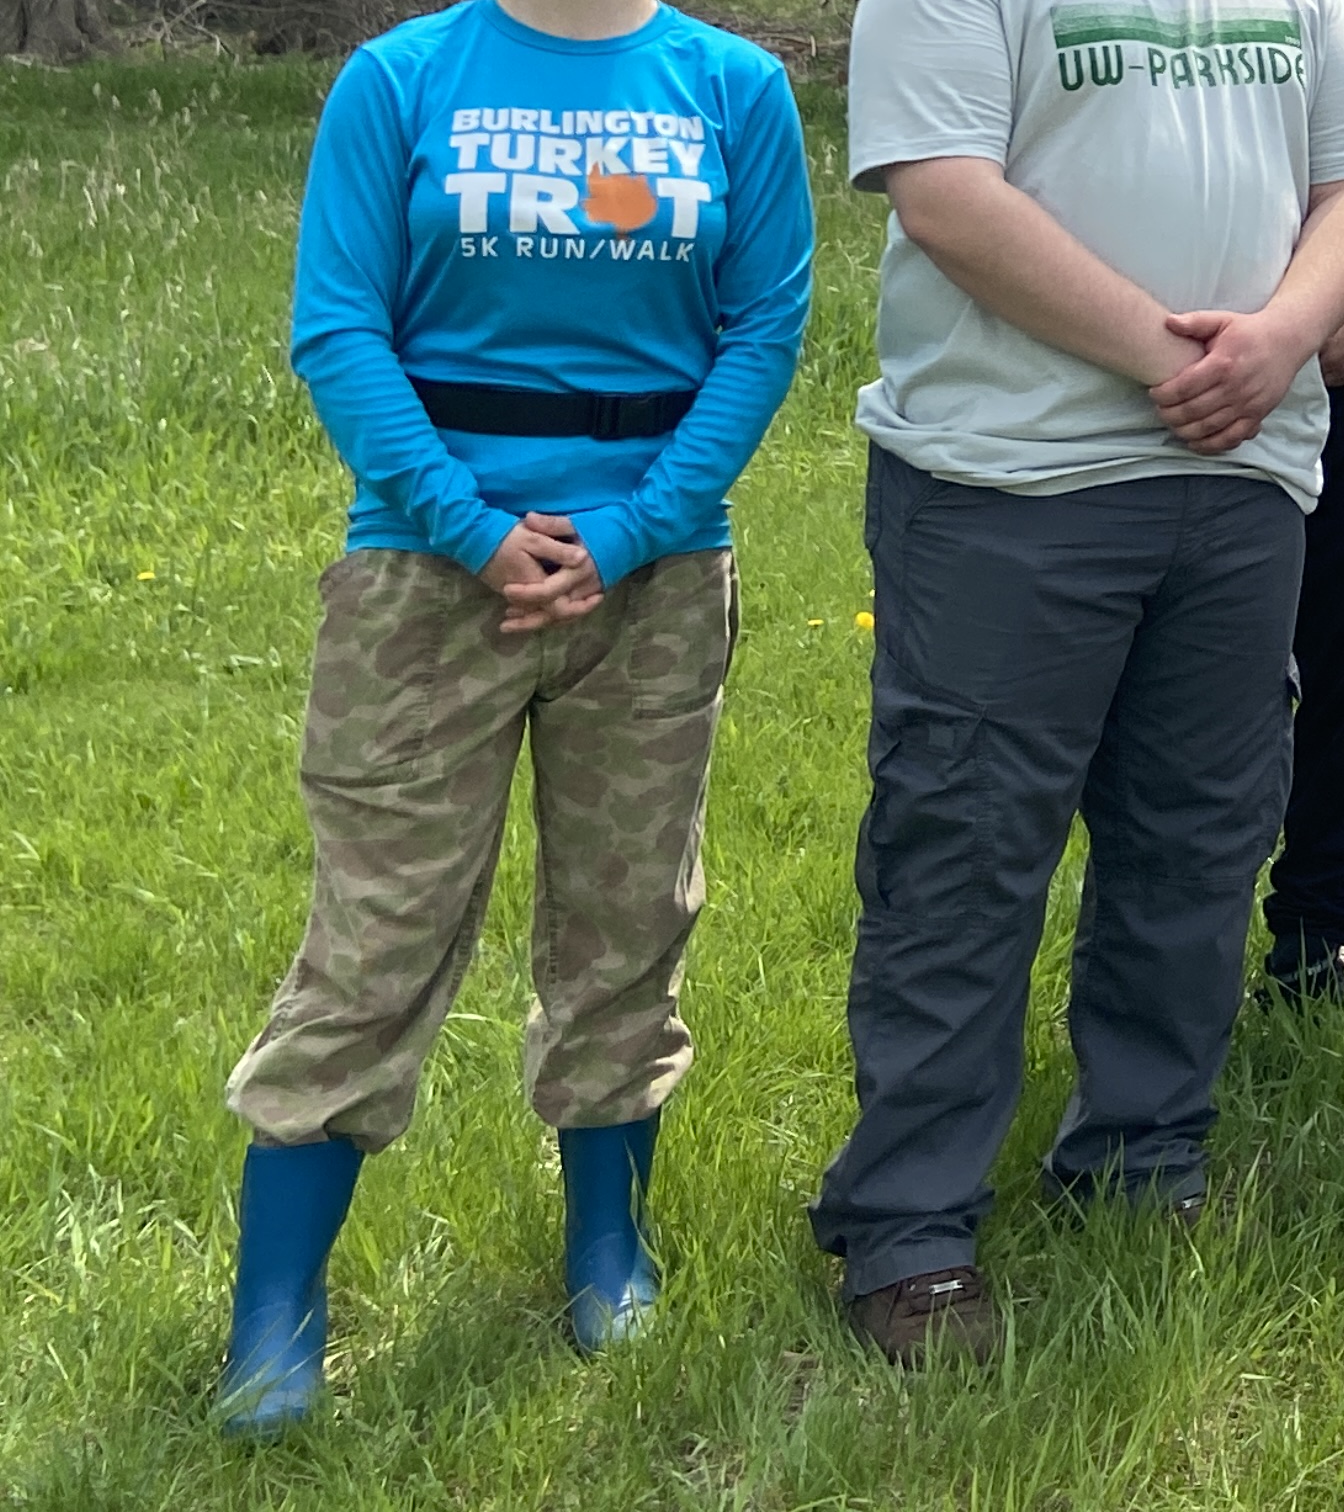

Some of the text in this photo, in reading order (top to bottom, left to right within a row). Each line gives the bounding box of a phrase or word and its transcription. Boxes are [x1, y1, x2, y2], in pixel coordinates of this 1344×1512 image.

[452, 107, 704, 139] BURLINGTON
[450, 134, 705, 176] TURKEY
[461, 237, 694, 262] 5K RUN/WALK
